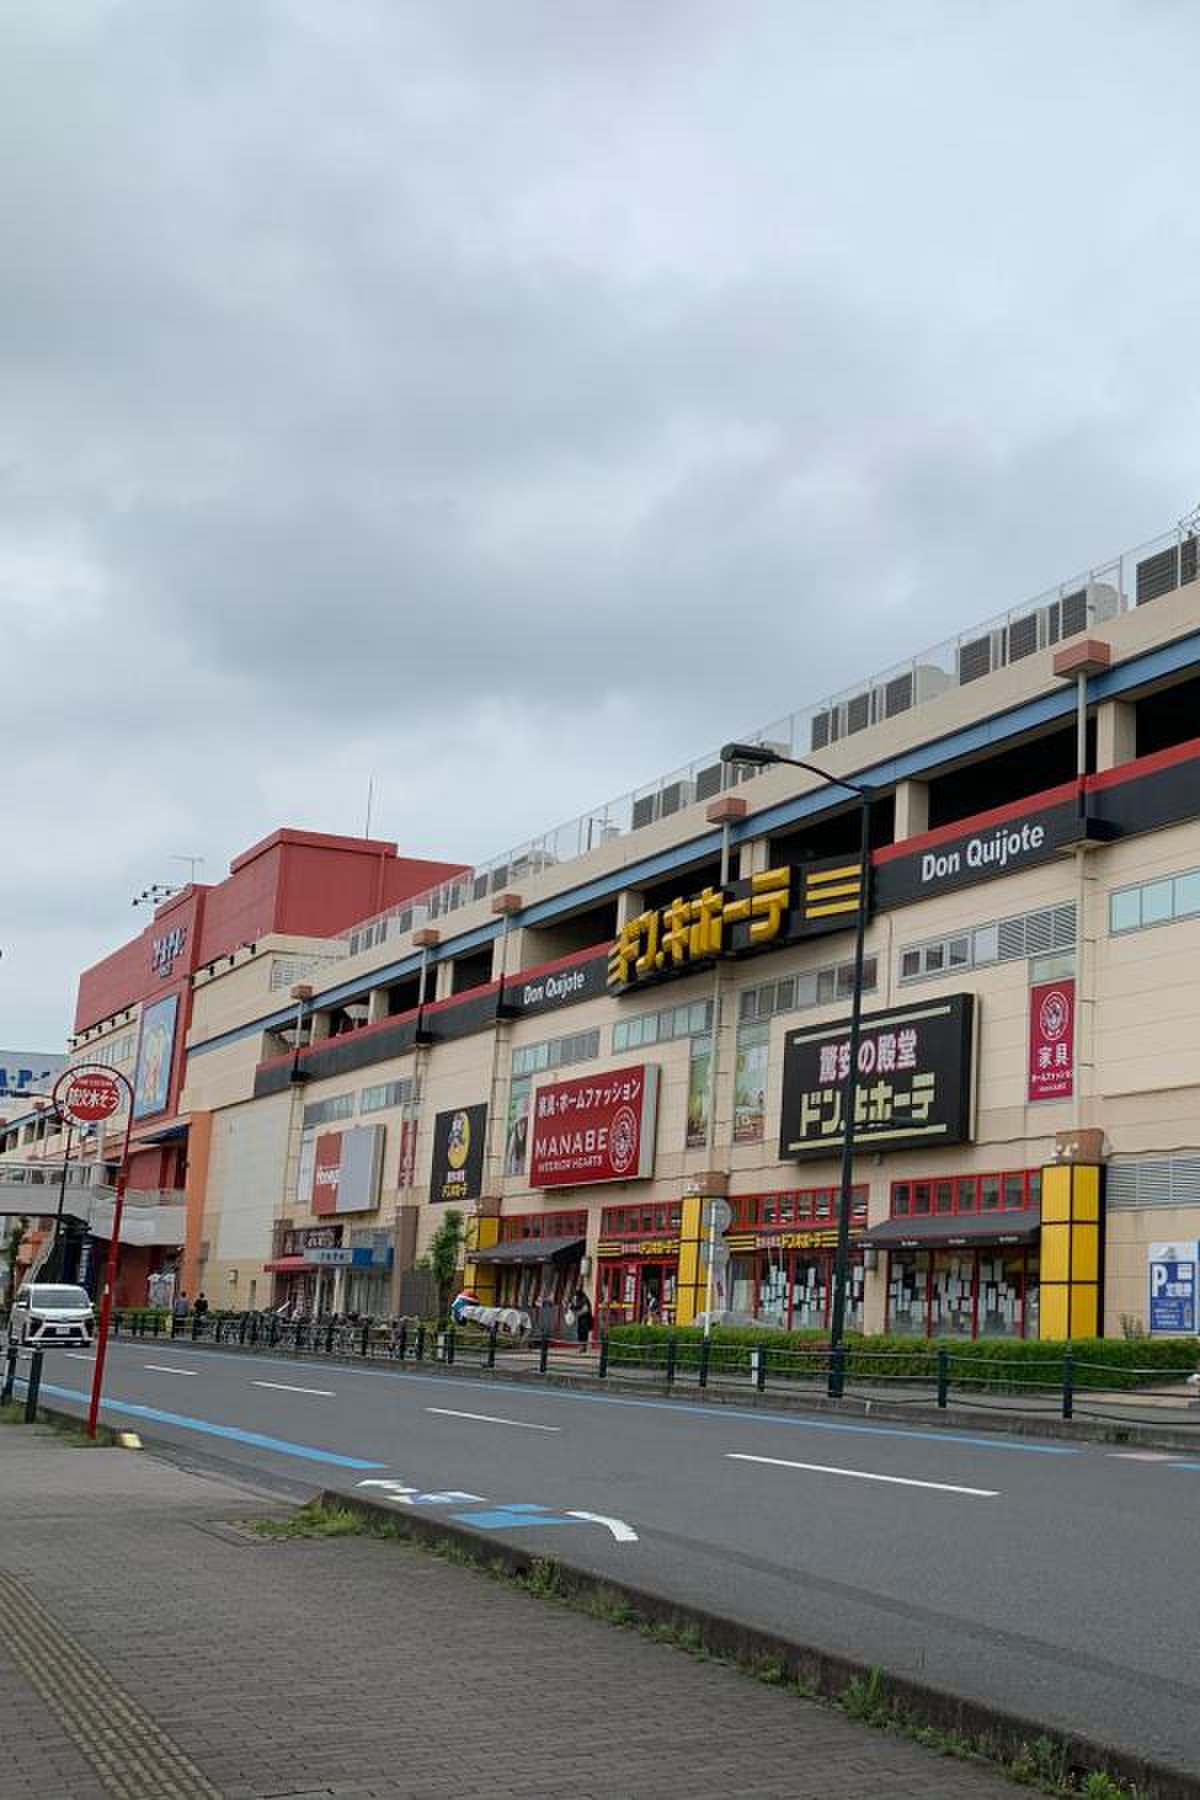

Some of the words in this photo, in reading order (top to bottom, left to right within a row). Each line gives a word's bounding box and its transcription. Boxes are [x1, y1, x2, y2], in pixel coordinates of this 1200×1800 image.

[921, 850, 961, 883] Don
[966, 823, 1045, 866] Quijote
[523, 985, 544, 1005] Don
[544, 970, 586, 999] Quijote
[1037, 1042, 1068, 1070] 家具
[534, 1127, 609, 1160] MANABE
[1151, 1263, 1169, 1297] P
